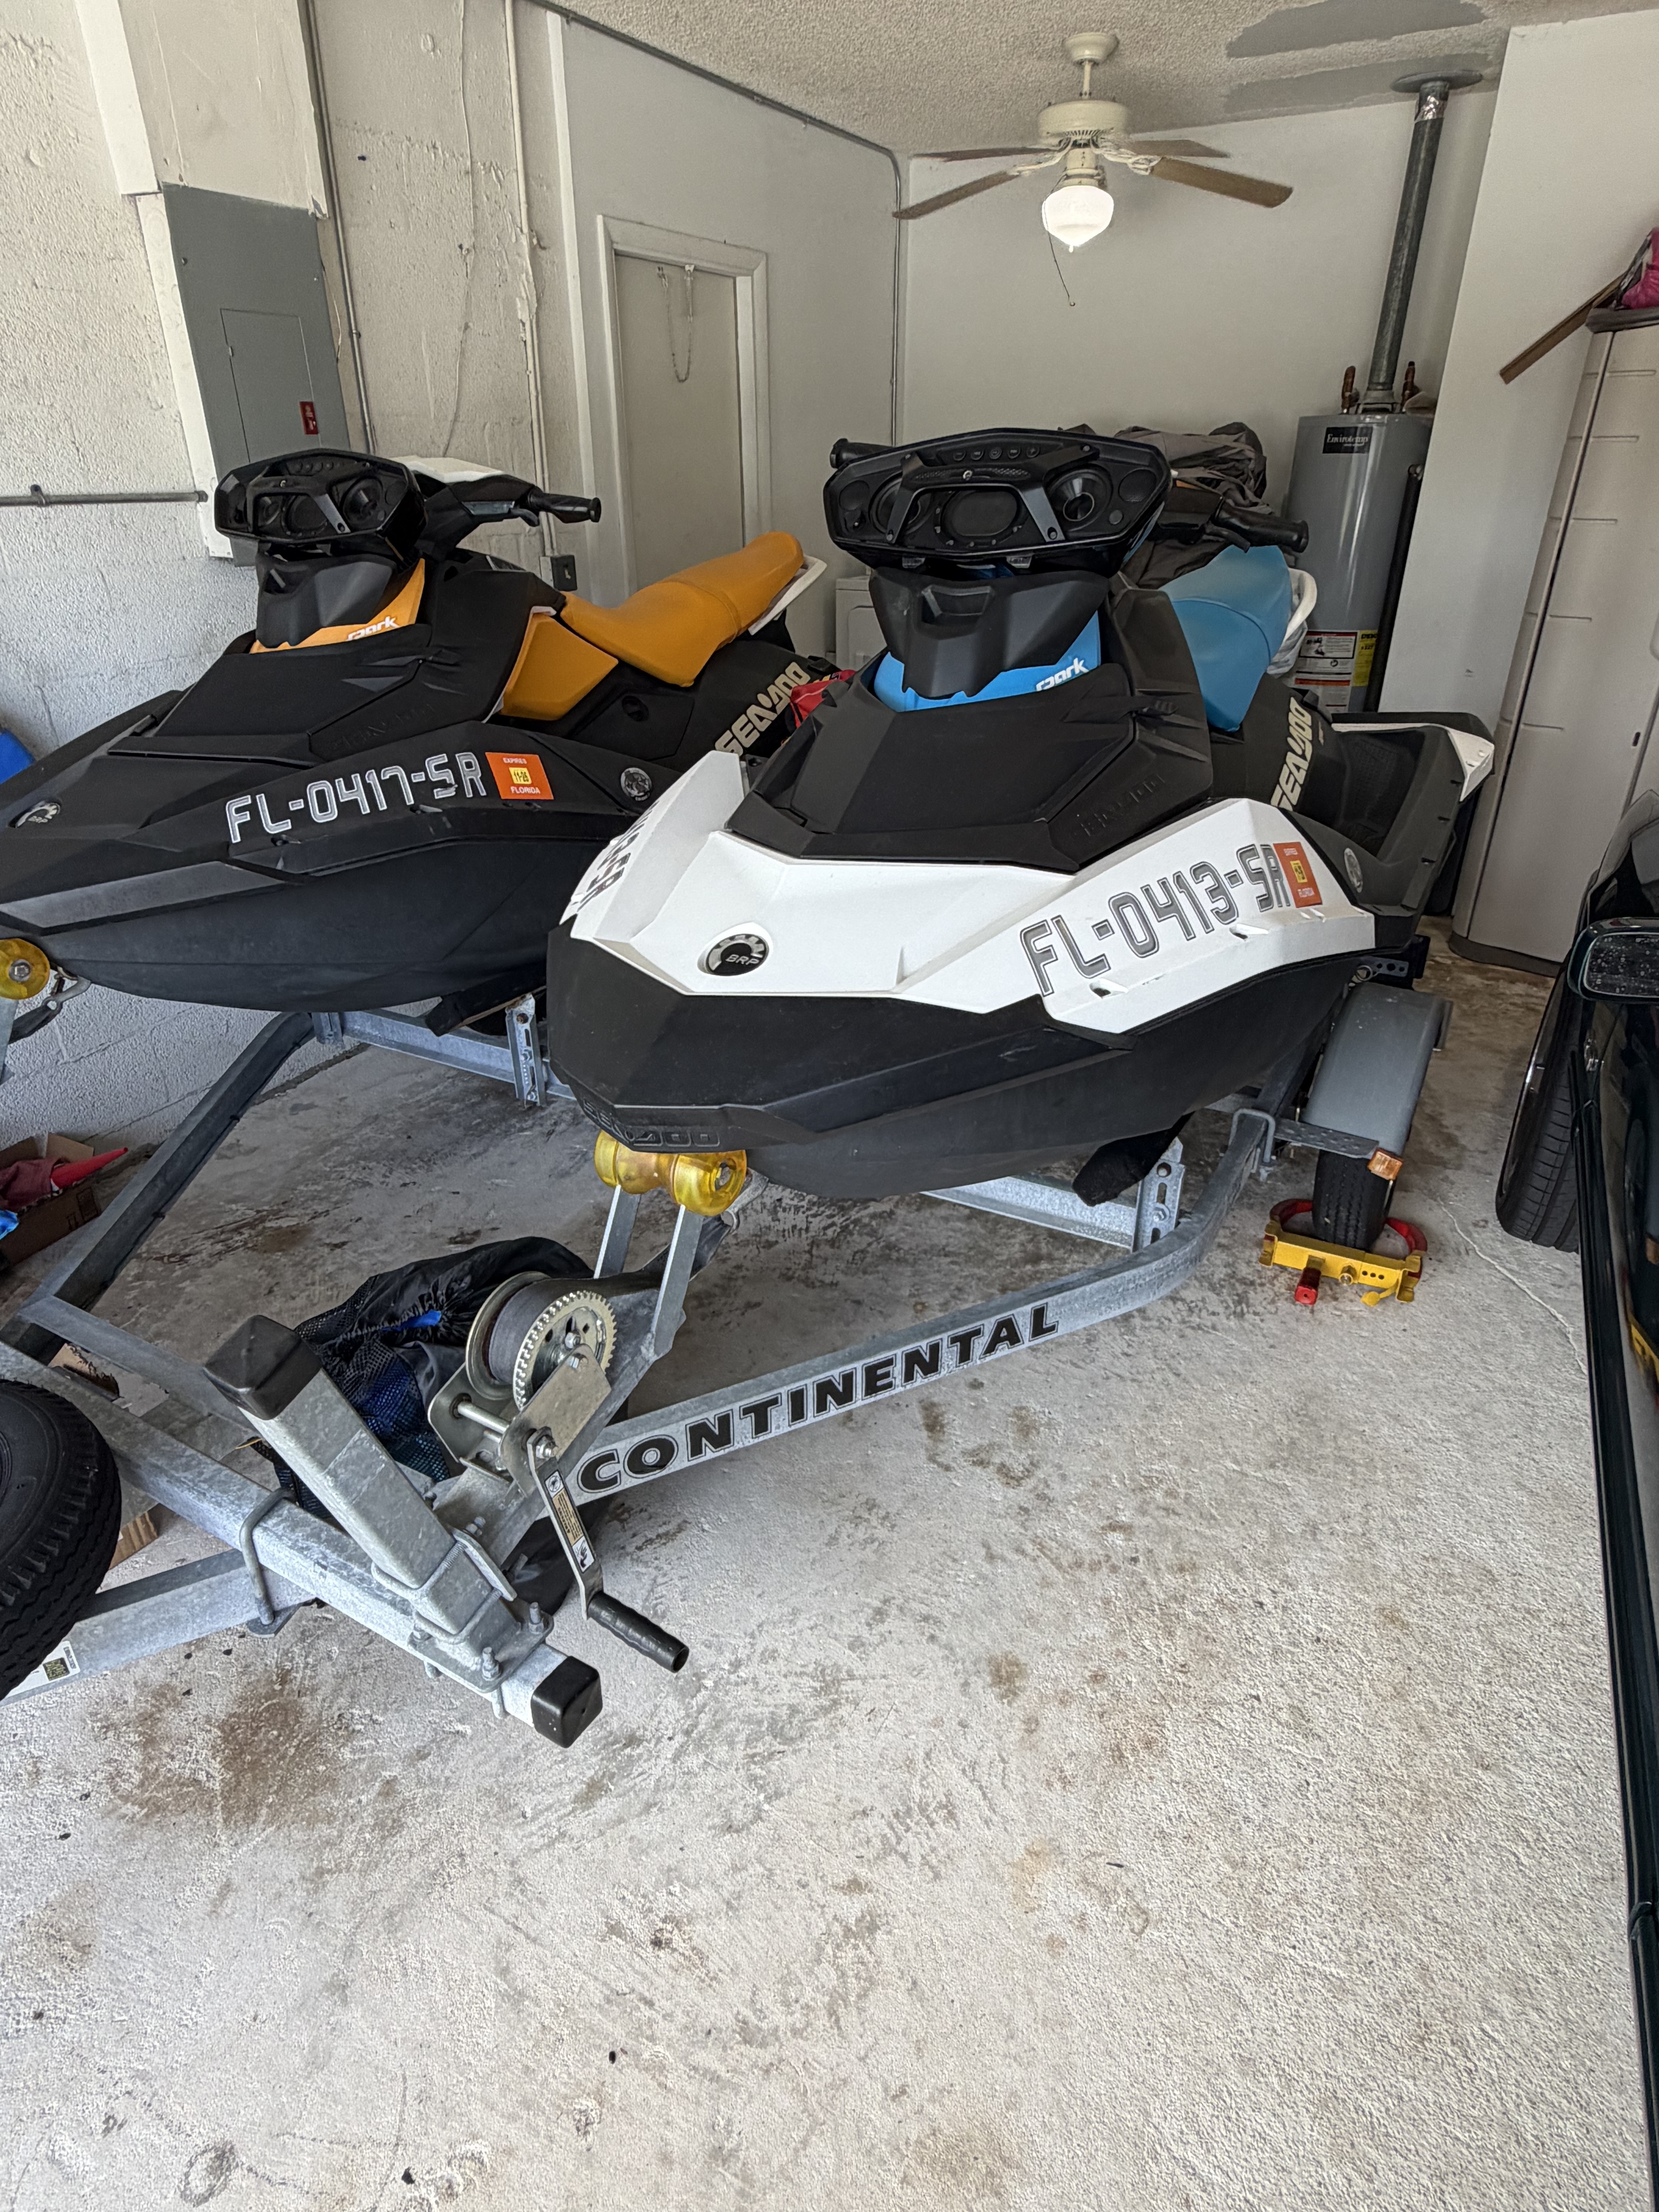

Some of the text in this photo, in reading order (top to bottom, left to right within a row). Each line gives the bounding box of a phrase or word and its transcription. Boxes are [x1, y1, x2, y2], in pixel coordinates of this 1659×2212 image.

[226, 752, 486, 843] FL-0417-SR
[725, 954, 759, 965] BRP
[1020, 843, 1291, 997] FL-0413-SR
[577, 1302, 1059, 1494] CONTINENTAL
